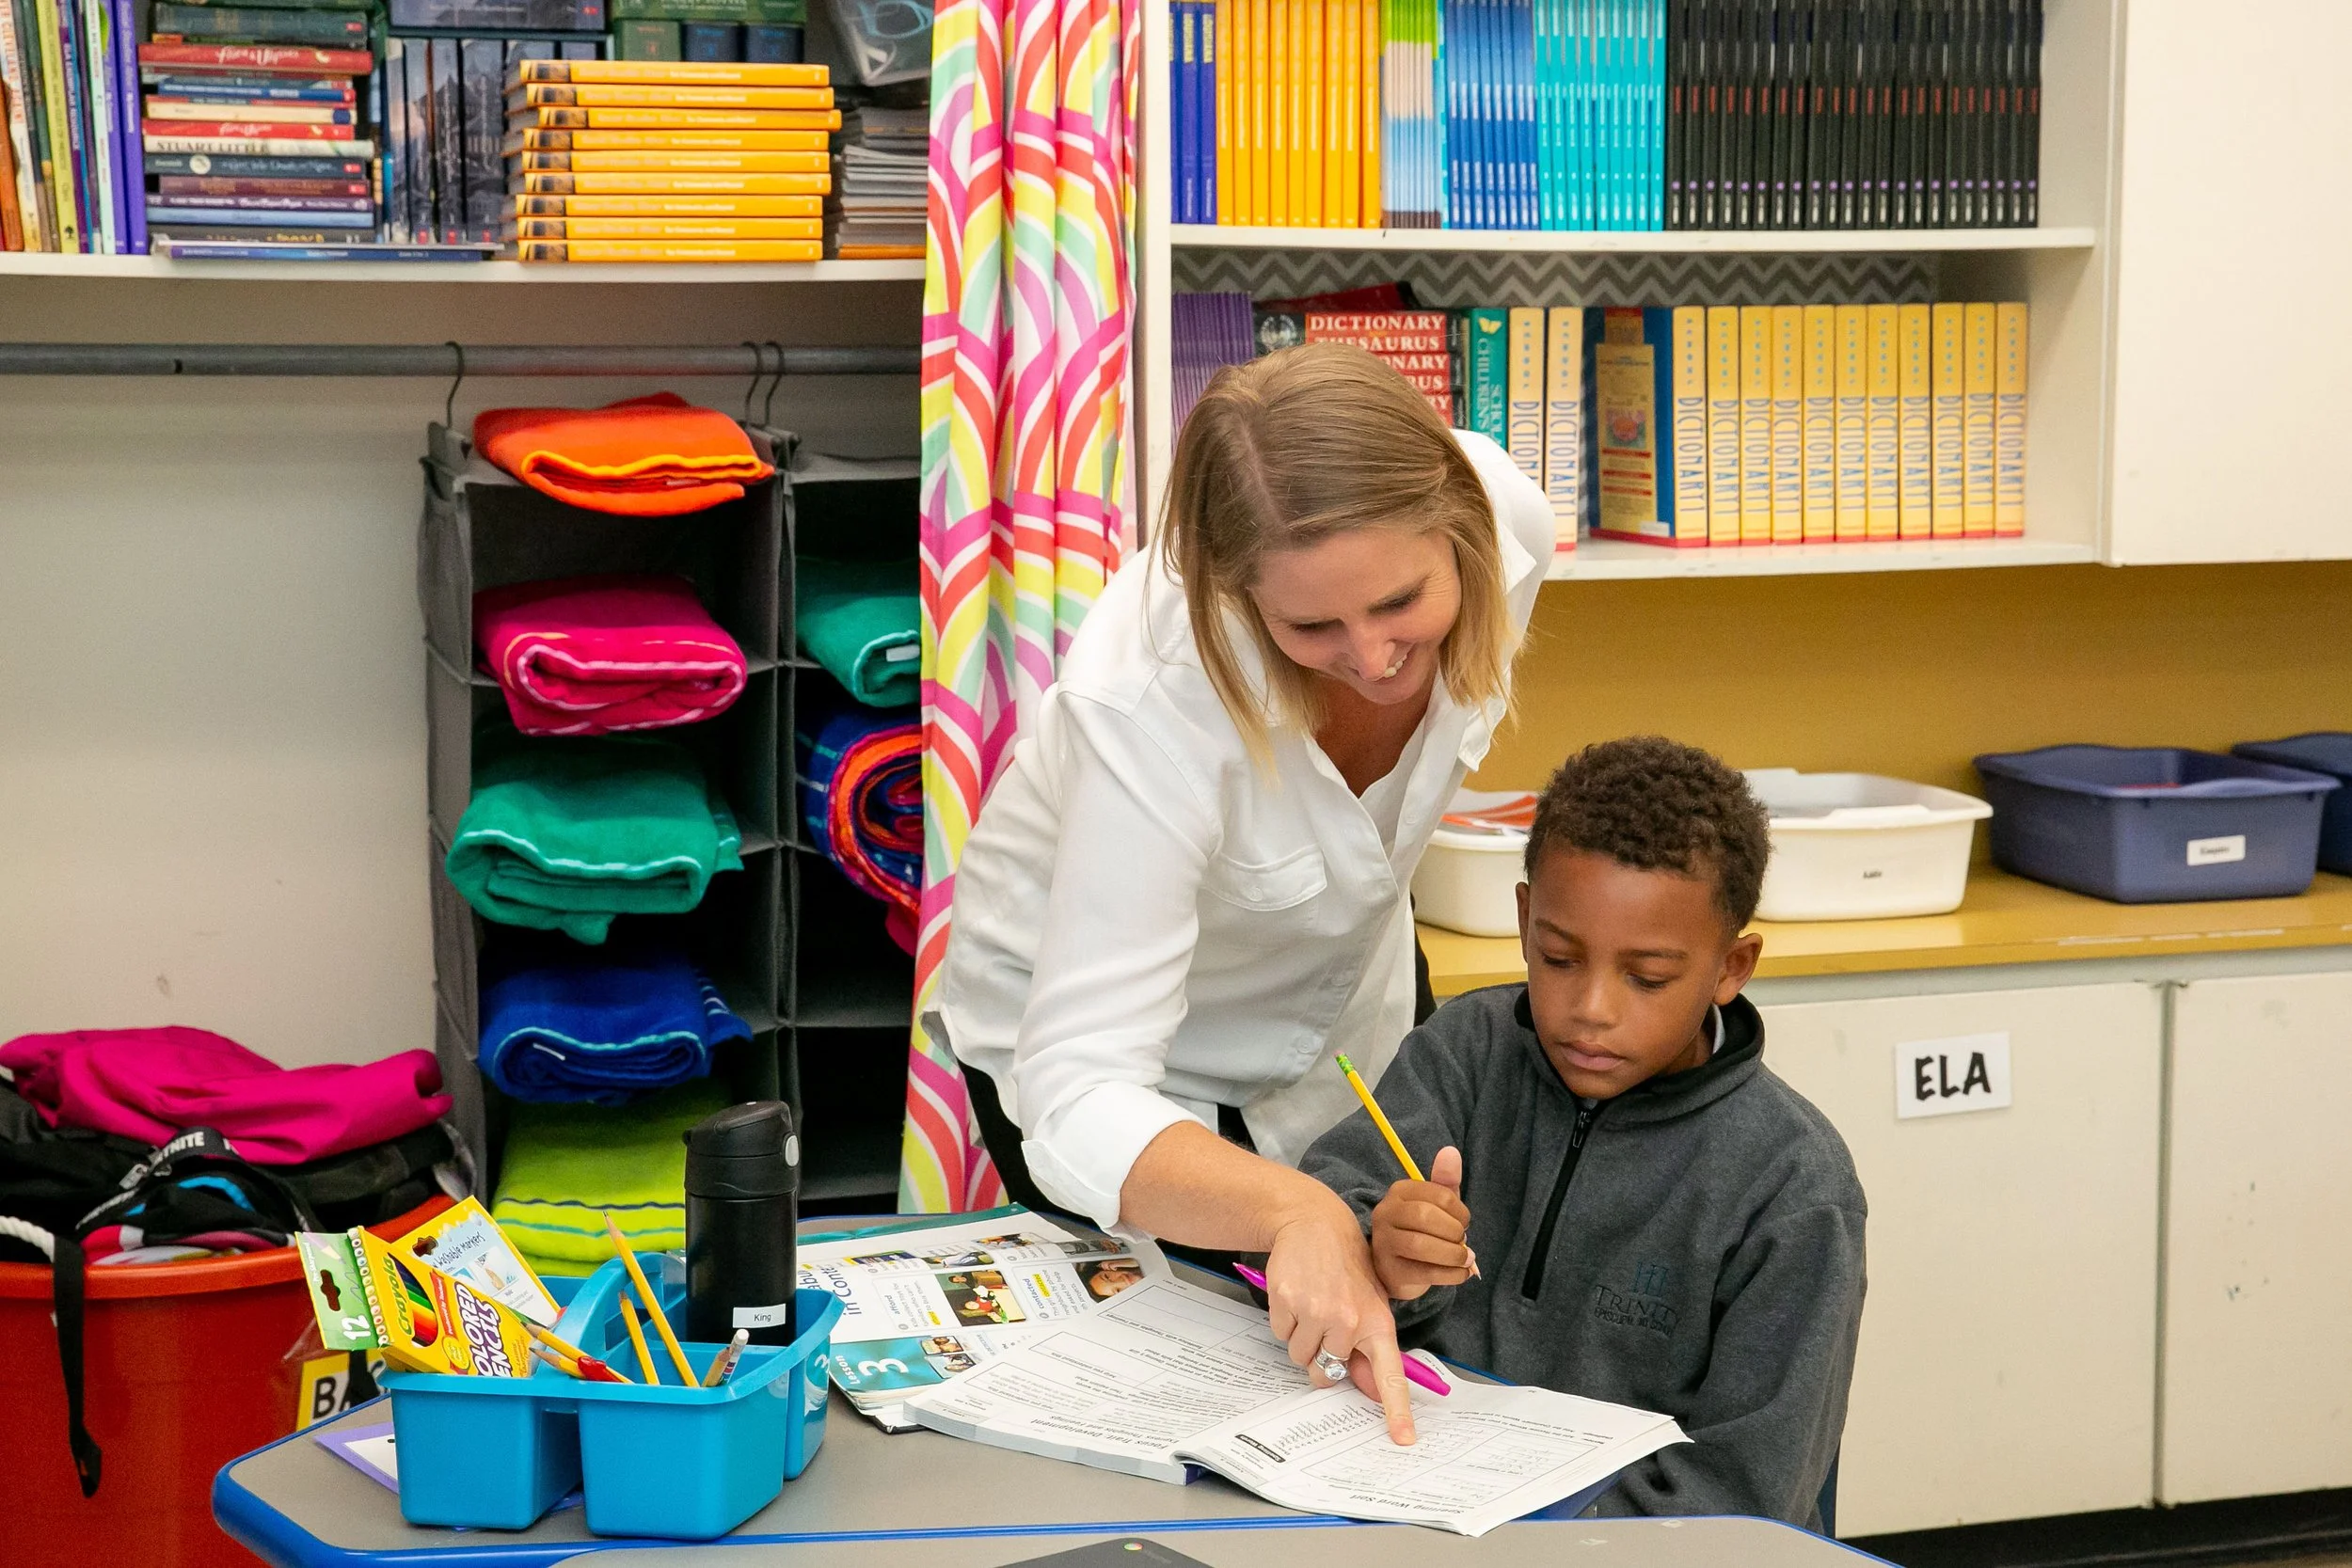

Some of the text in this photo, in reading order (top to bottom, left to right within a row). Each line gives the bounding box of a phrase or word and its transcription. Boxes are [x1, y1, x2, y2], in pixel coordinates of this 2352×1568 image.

[157, 141, 214, 152] STUART
[1311, 315, 1444, 330] DICTIONARY
[1513, 402, 1539, 480] DICTION
[1549, 402, 1578, 505] DICTIONARY
[1915, 1052, 1992, 1101] ELA
[384, 1257, 412, 1336] Crayola
[882, 1294, 900, 1315] afford
[1022, 1277, 1044, 1308] contacted
[754, 1312, 771, 1323] King
[843, 1302, 862, 1315] in
[342, 1315, 372, 1340] 12
[455, 1282, 494, 1376] OLORED
[475, 1298, 511, 1377] ENCILS
[835, 1355, 909, 1385] Lesson 3
[1030, 1418, 1103, 1437] Development
[1135, 1440, 1169, 1449] Focus
[1349, 1495, 1465, 1514] Spelling Word Sort
